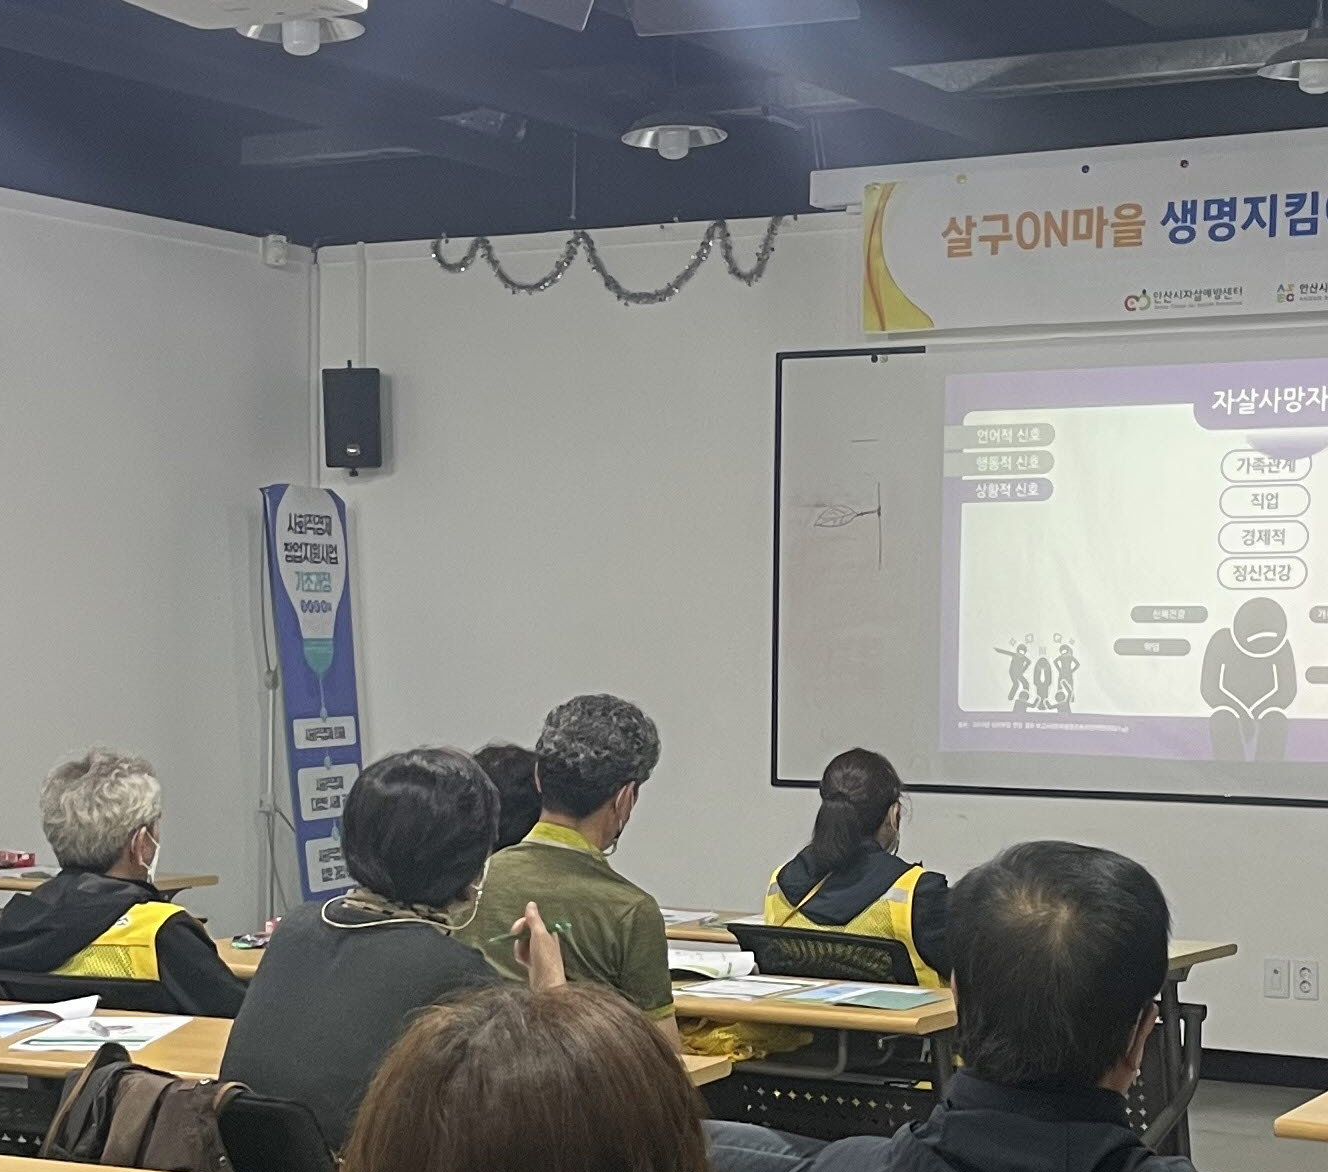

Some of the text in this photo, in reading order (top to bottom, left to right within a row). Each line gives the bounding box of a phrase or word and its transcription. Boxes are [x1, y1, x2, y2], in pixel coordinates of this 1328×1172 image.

[940, 200, 1146, 258] 살구ON마을
[976, 426, 1041, 444] 언어적 신호
[976, 454, 1040, 472] 행동적 신호
[1236, 457, 1297, 475] 가족관계
[975, 481, 1039, 499] 상황적 신호
[1250, 492, 1280, 510] 직업
[1241, 528, 1286, 547] 경제적
[1232, 564, 1292, 582] 정신건강
